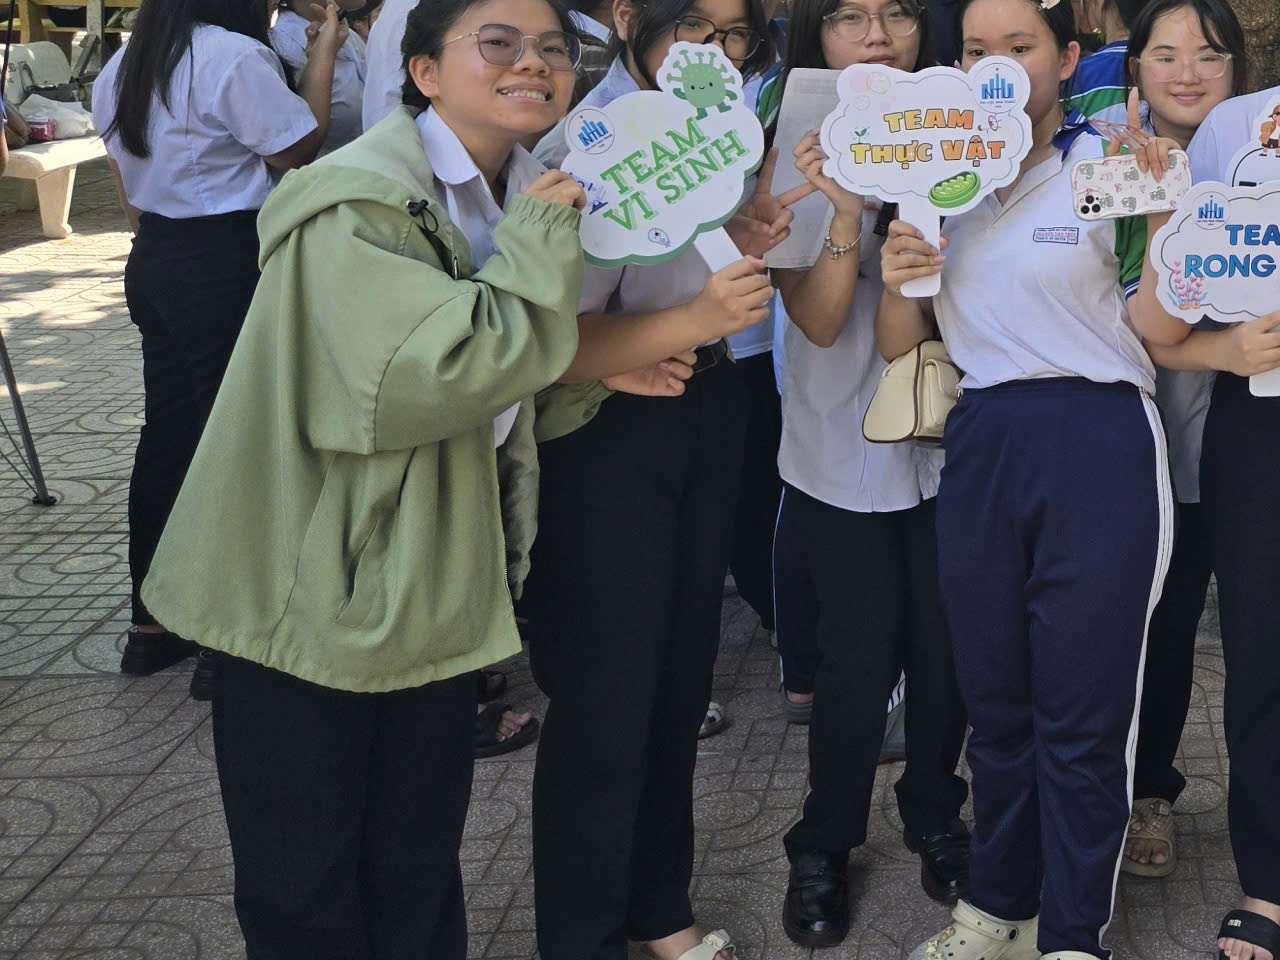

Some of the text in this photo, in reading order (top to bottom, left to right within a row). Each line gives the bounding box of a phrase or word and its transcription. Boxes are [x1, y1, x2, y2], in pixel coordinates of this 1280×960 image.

[884, 108, 975, 134] TEAM
[599, 116, 708, 195] TEAM
[850, 135, 1005, 170] THỰC VẬT
[602, 128, 746, 231] VI SINH
[1184, 254, 1277, 278] RONG
